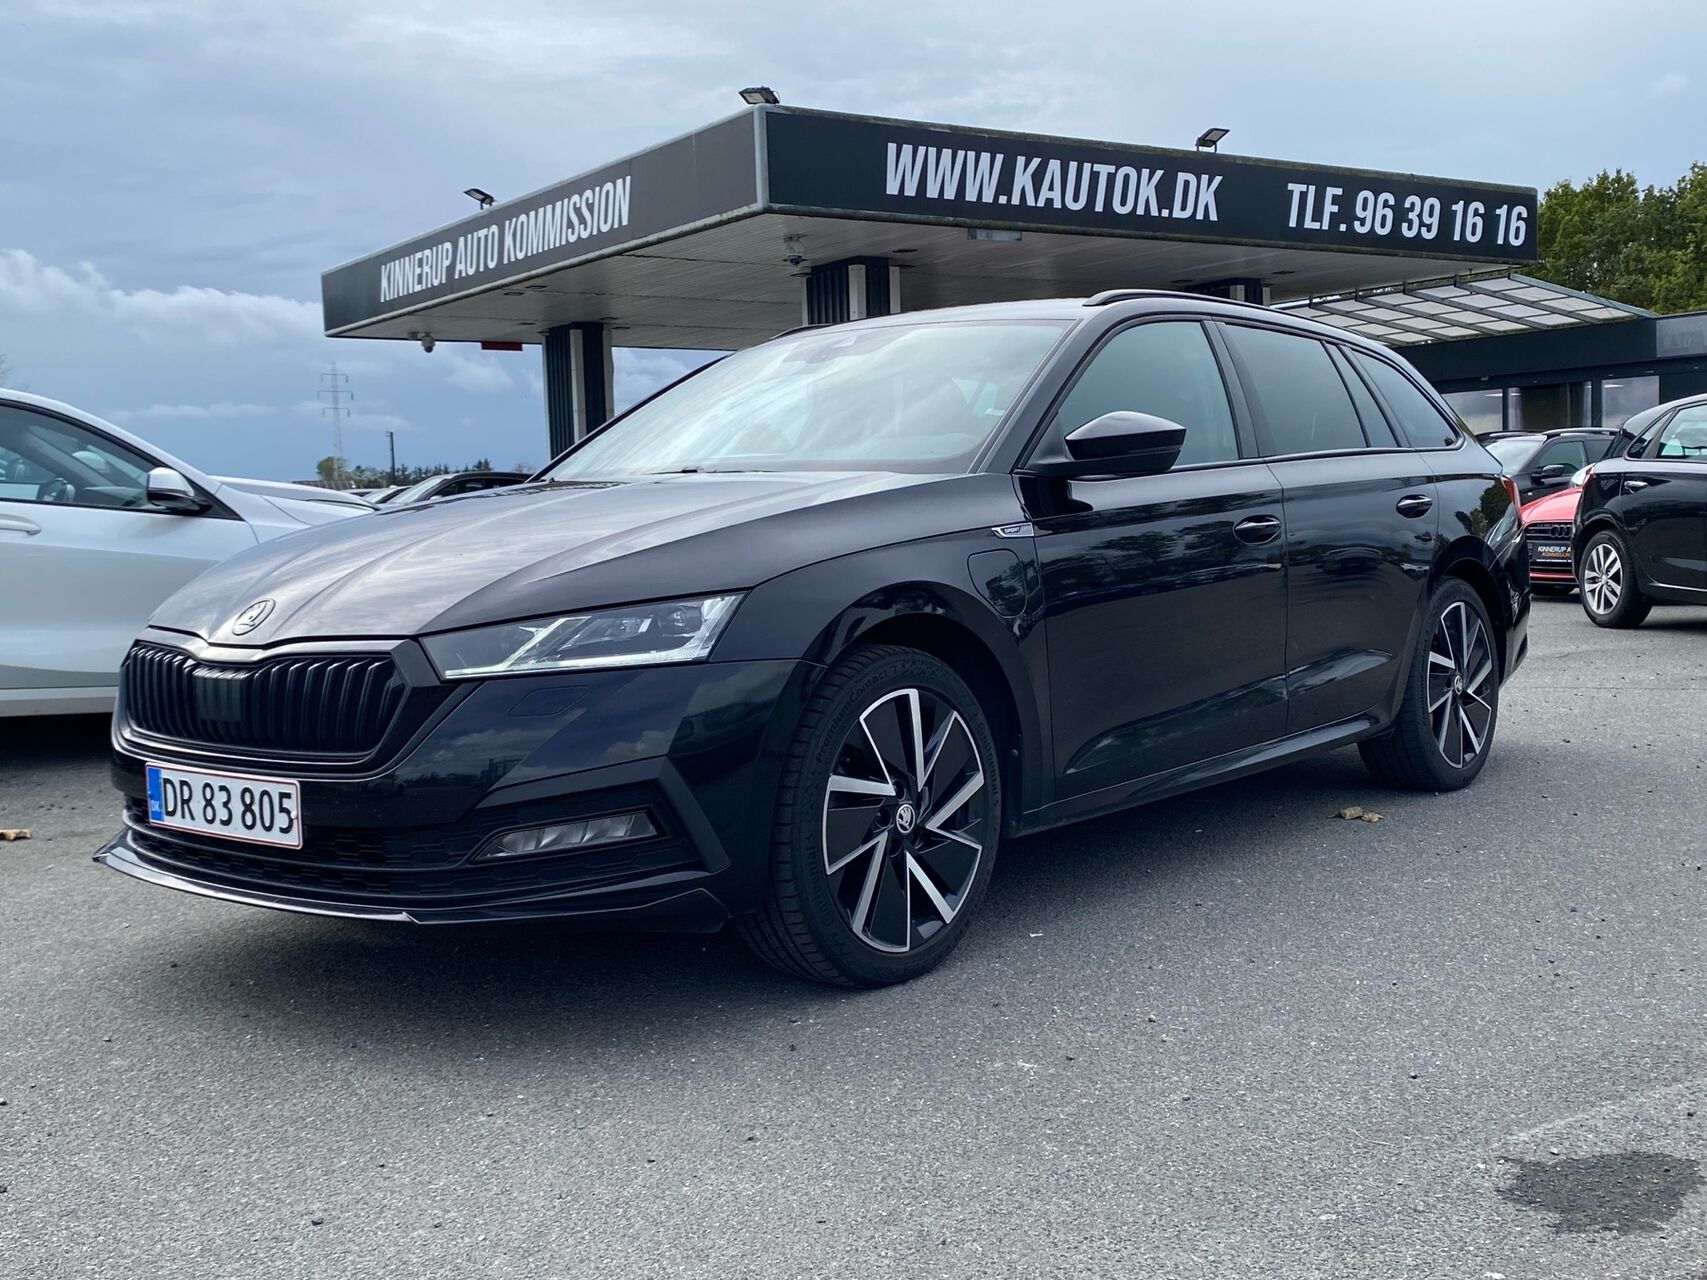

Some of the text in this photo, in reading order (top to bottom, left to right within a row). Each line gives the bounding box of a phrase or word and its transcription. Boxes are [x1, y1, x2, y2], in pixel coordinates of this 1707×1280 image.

[886, 142, 1223, 223] WWW.KAUTOK.DK
[1287, 182, 1528, 247] TLF. 96 39 16 16
[380, 175, 632, 303] KINNERUP AUTO KOMMISSION
[162, 776, 294, 834] DR 83 805
